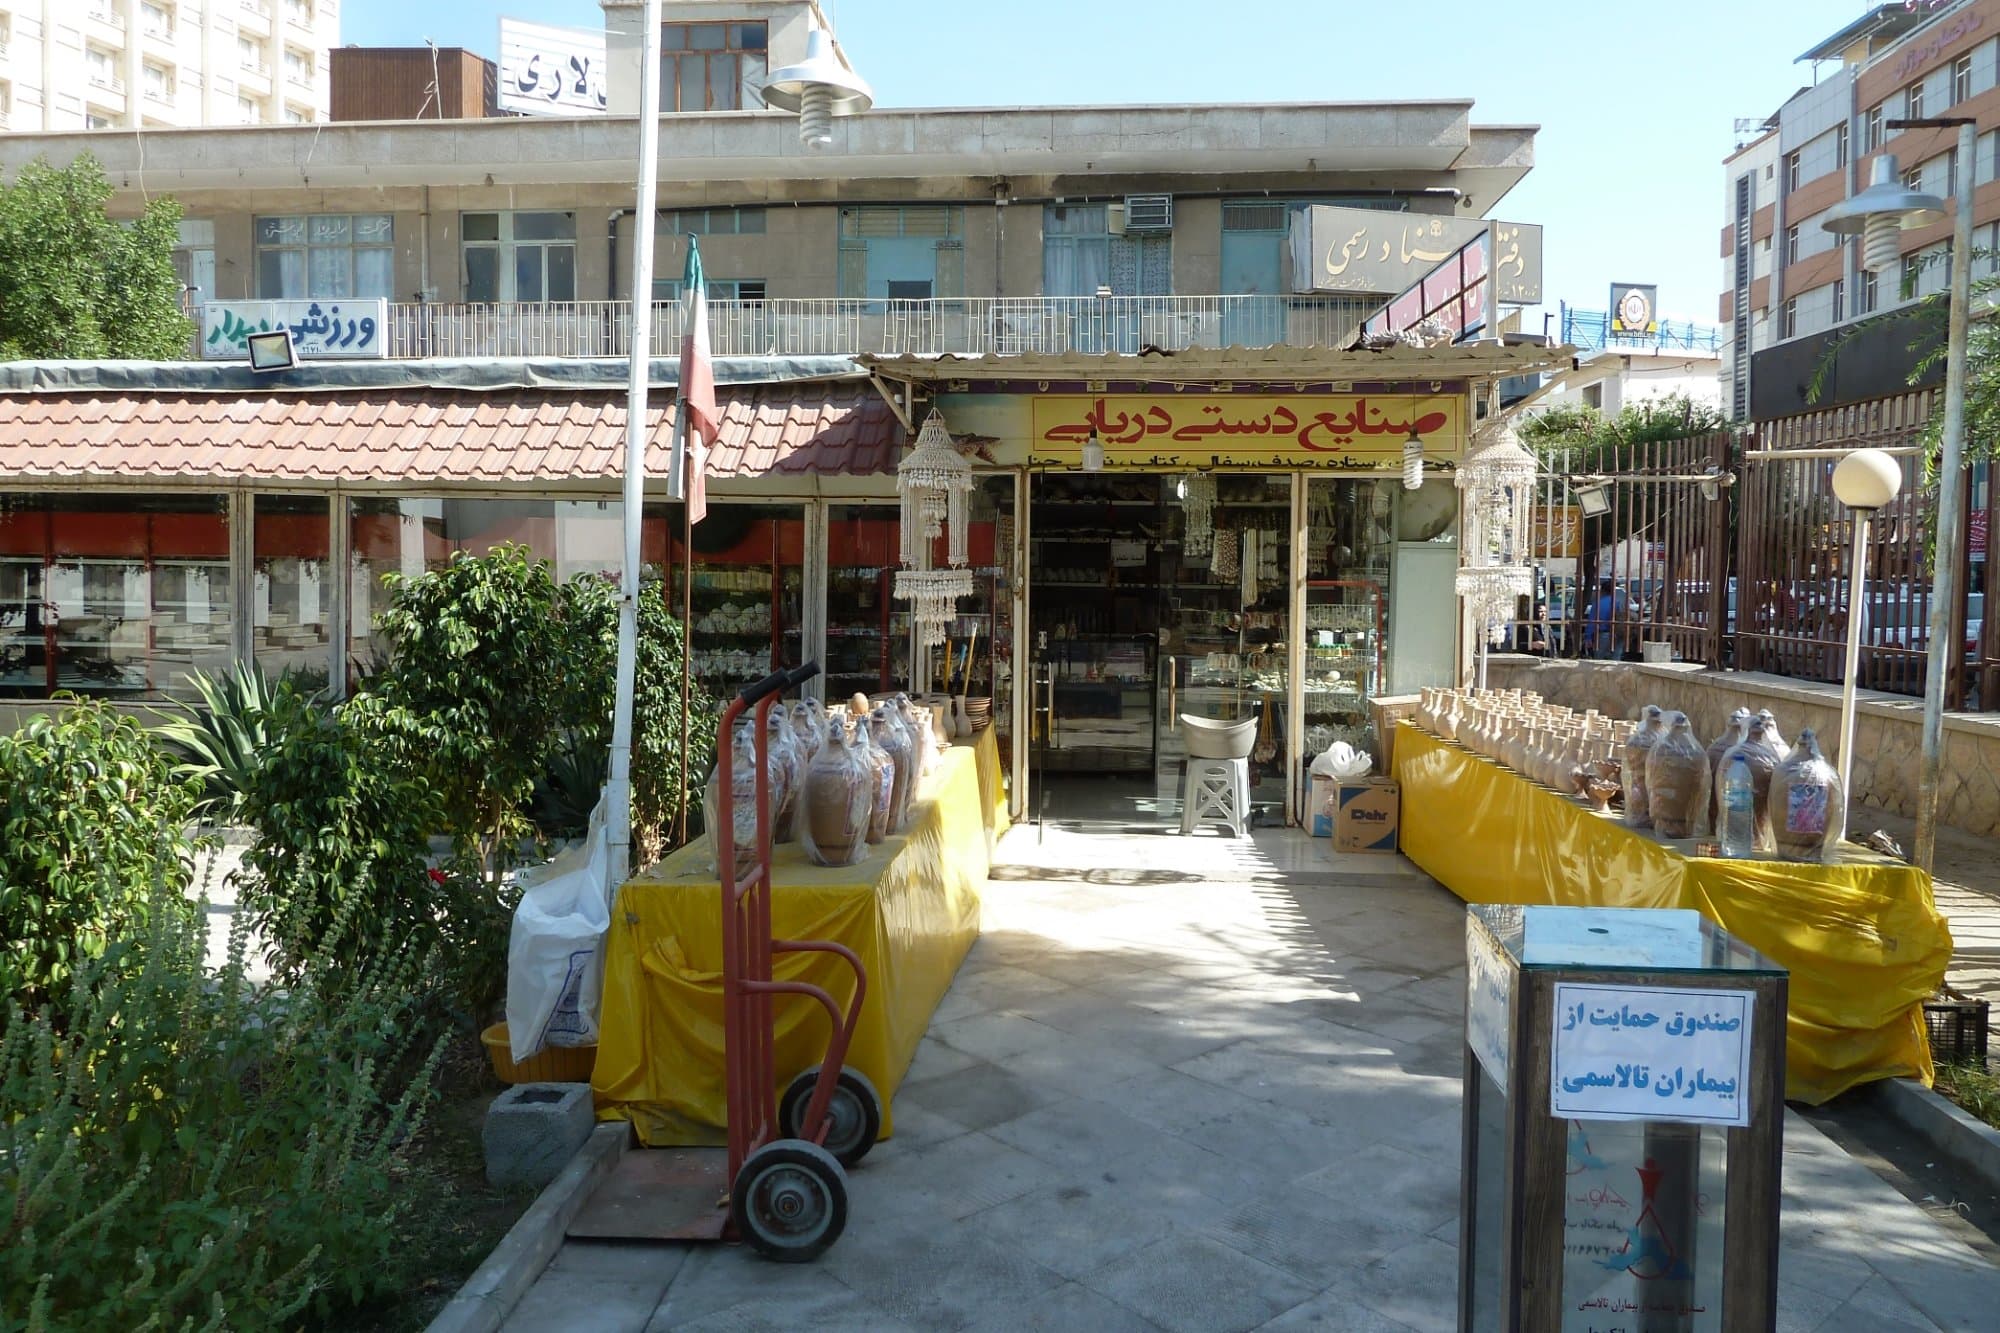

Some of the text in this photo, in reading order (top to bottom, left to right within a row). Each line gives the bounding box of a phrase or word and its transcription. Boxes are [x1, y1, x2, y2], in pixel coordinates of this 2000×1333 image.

[518, 54, 591, 101] لاری
[1326, 227, 1369, 275] رسمی
[1044, 397, 1448, 452] صنایع دستی دریایی
[1562, 1002, 1741, 1036] صندوق حمایت از
[1562, 1063, 1737, 1100] بیماران تالاسمی
[1577, 1297, 1609, 1312] تالاسمی
[1610, 1298, 1638, 1313] بیماران
